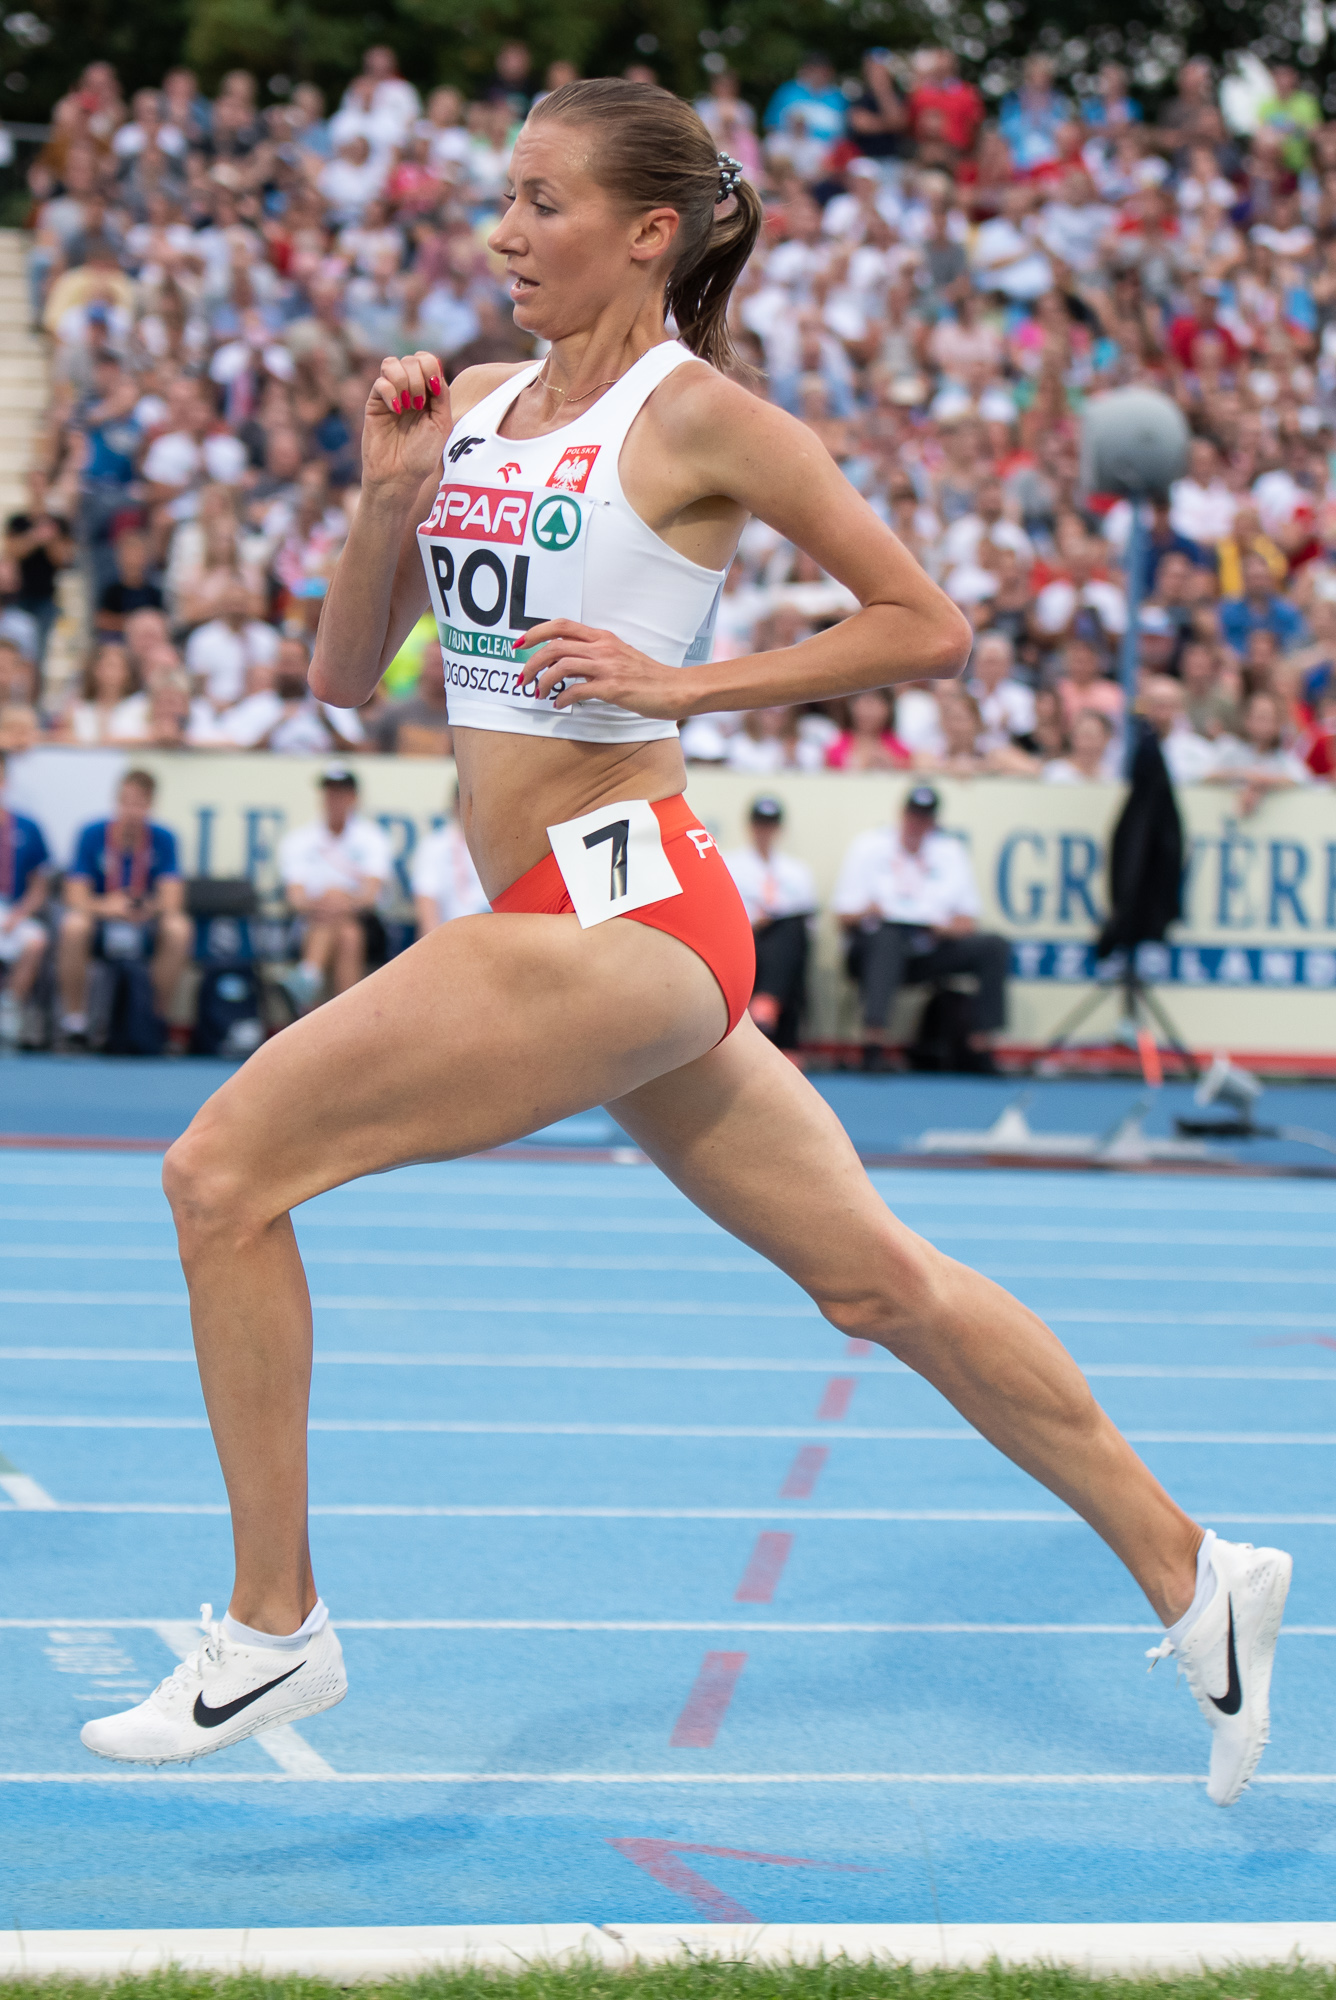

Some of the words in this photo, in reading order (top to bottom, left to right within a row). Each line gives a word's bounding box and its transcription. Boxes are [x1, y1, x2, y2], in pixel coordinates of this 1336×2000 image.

[566, 447, 597, 455] POLSKA
[426, 490, 527, 537] SPAR
[430, 545, 552, 631] POL
[452, 631, 473, 652] RUN
[477, 635, 516, 659] CLEAN
[512, 673, 566, 700] 209
[582, 819, 630, 901] 7
